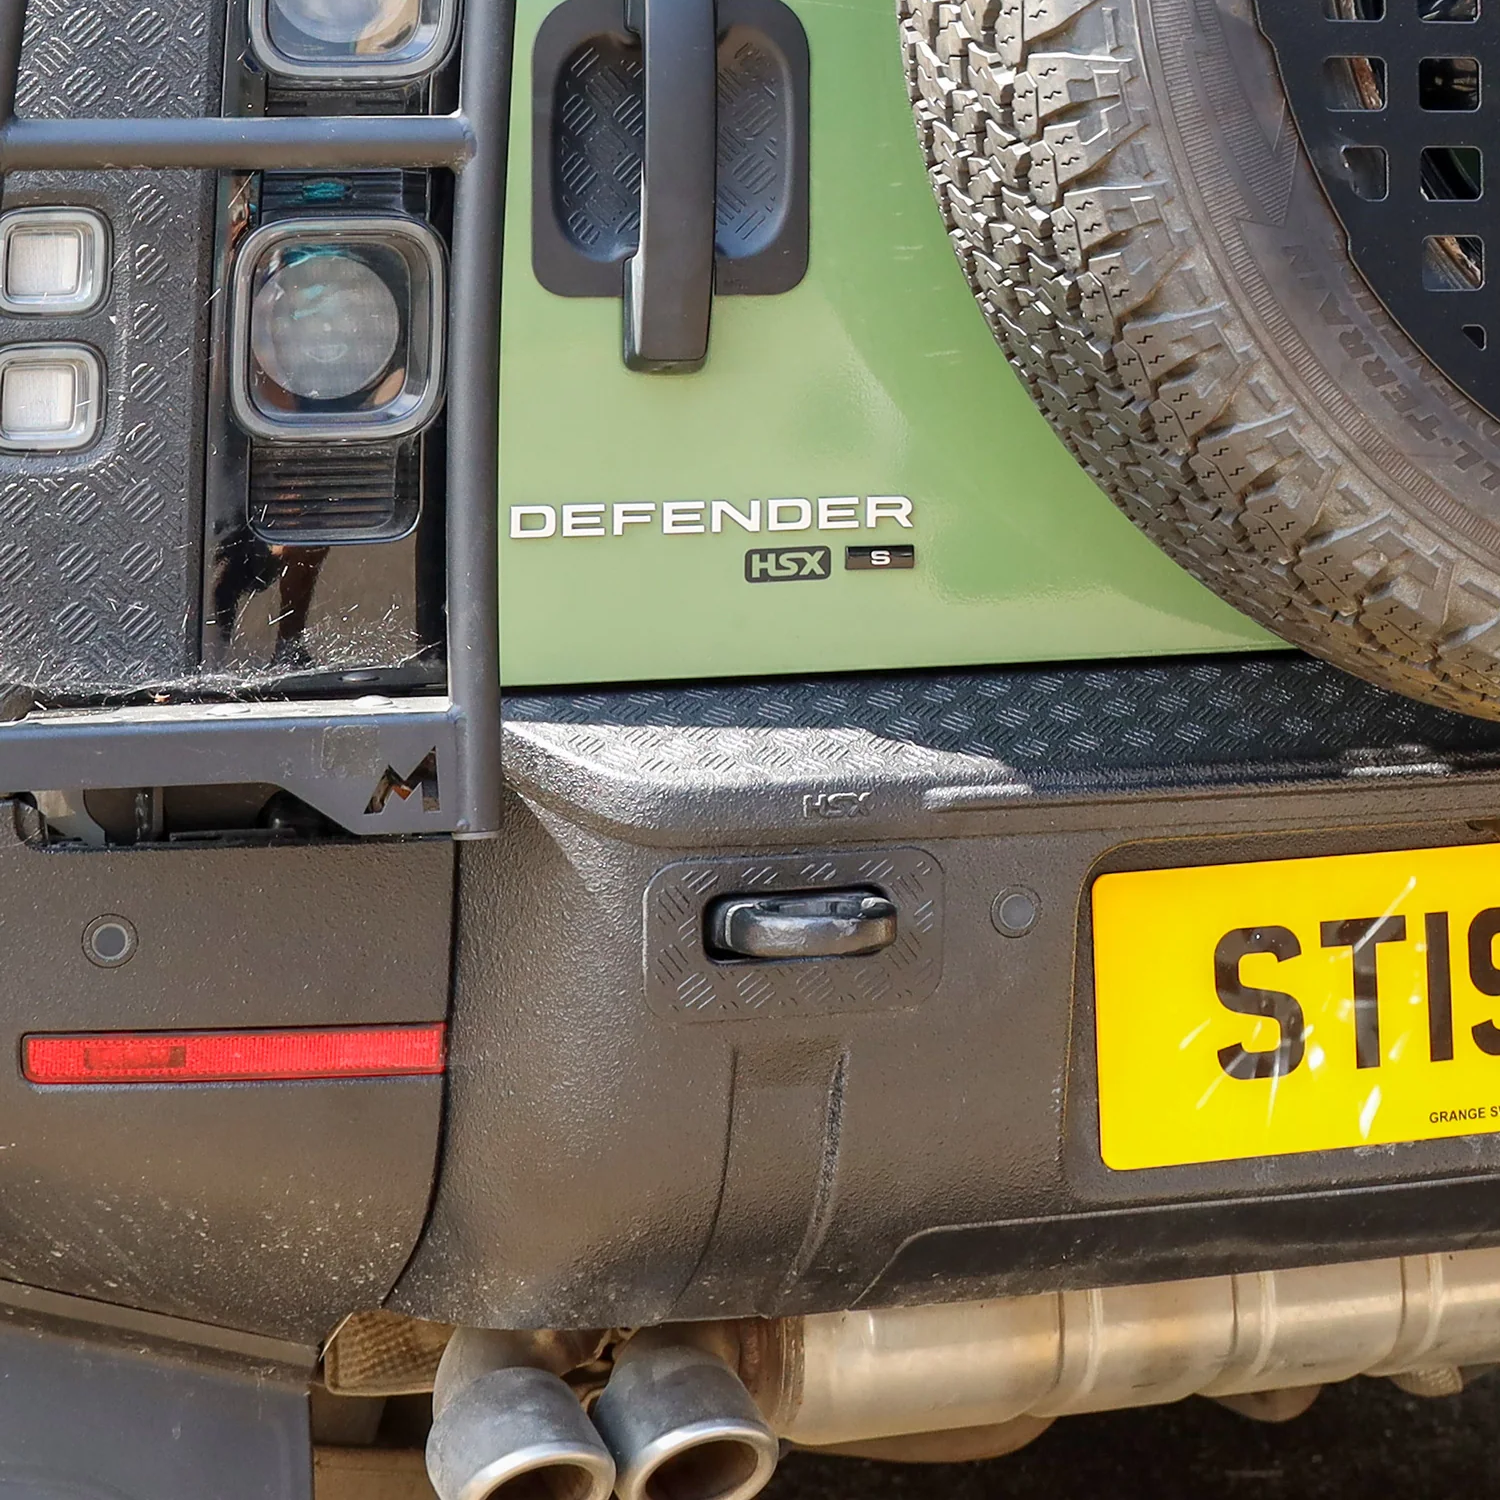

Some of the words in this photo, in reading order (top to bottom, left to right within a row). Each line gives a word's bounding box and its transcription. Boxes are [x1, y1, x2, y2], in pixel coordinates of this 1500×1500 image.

[509, 495, 914, 539] DEFENDER
[751, 550, 826, 579] HSX
[870, 550, 892, 566] S
[1429, 1107, 1486, 1124] GRANGE
